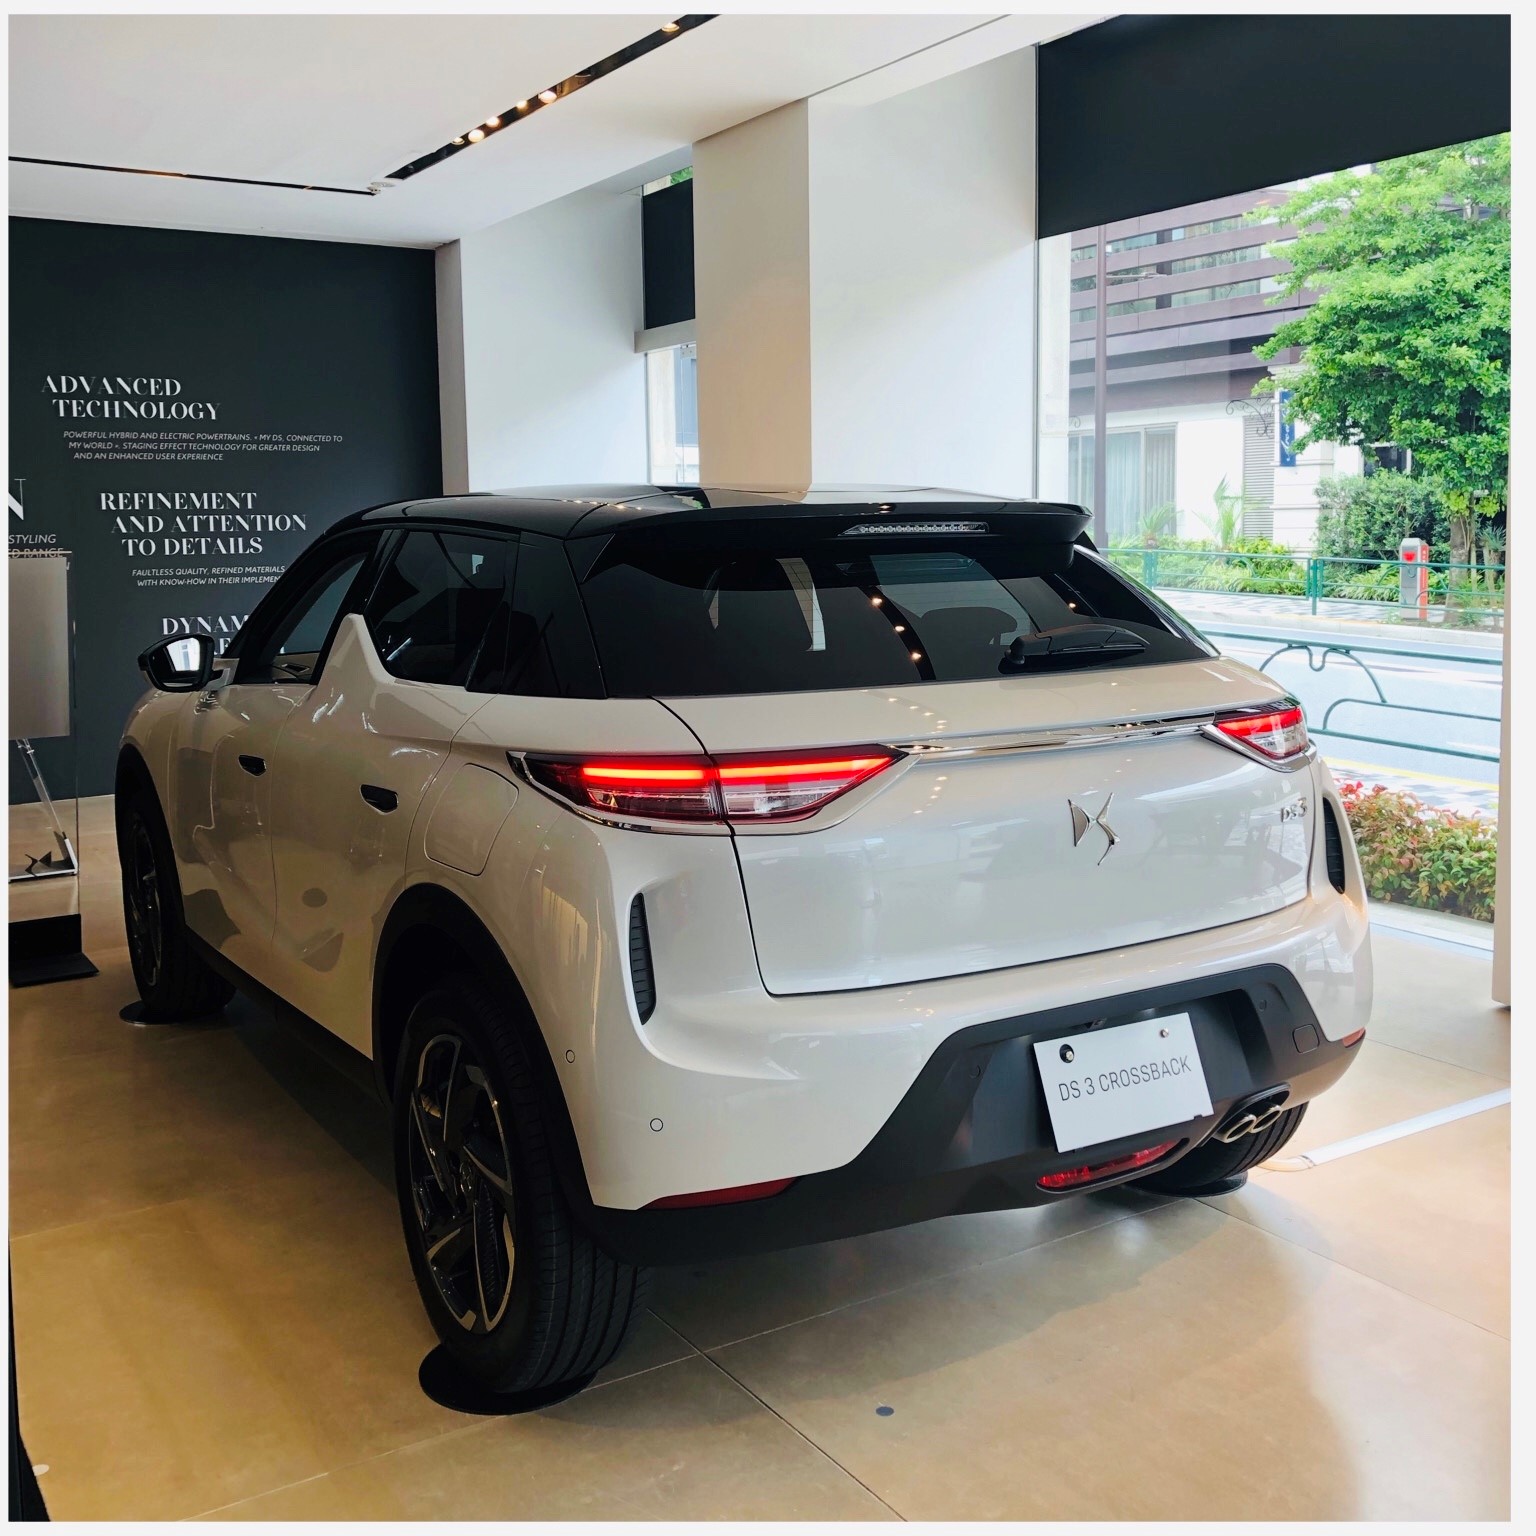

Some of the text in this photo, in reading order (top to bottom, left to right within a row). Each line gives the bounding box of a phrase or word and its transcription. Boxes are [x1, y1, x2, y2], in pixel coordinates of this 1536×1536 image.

[42, 375, 181, 396] ADVANCED
[52, 399, 221, 420] TECHNOLOGY
[109, 431, 138, 439] HYBRID
[140, 432, 158, 440] AND
[160, 432, 194, 440] ELECTRIC
[122, 442, 157, 450] STAGING
[100, 492, 257, 510] REFINEMENT
[112, 514, 307, 533] AND ATTENTION
[9, 534, 56, 544] STYLING
[122, 536, 263, 556] TO DETAILS
[245, 566, 285, 574] MATERIALS
[160, 578, 206, 586] KNOW-HOW
[1059, 1056, 1191, 1101] DS 3 CROSSBACK
